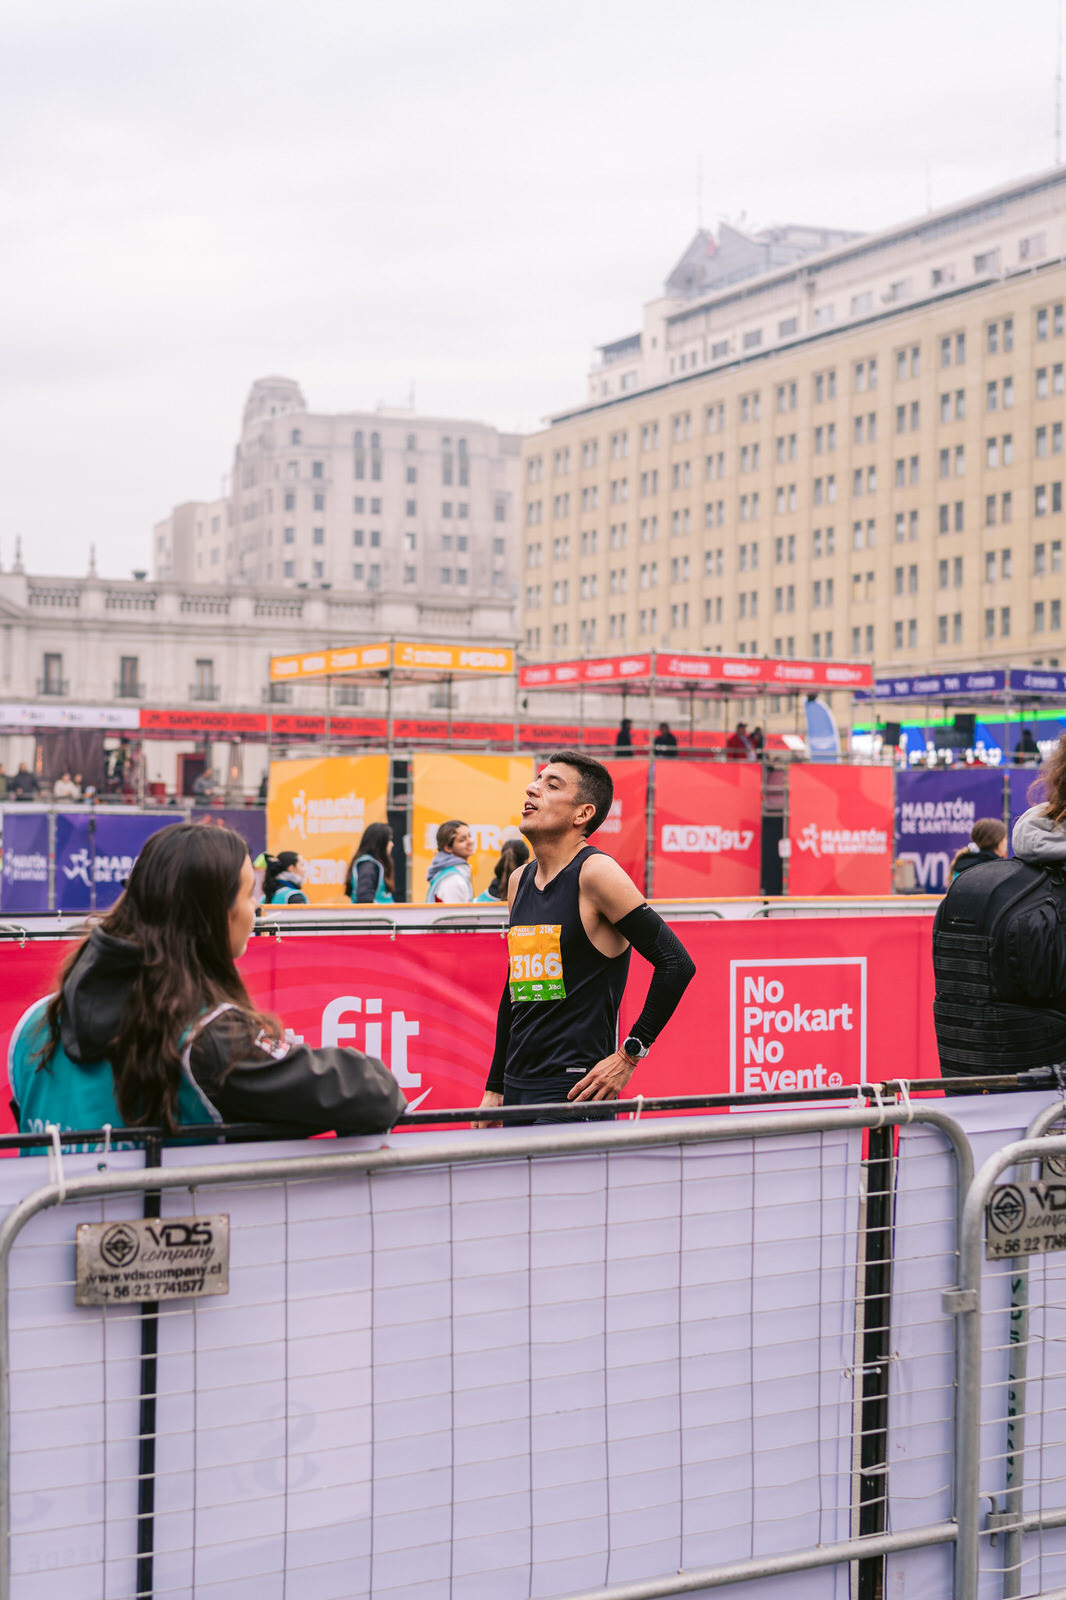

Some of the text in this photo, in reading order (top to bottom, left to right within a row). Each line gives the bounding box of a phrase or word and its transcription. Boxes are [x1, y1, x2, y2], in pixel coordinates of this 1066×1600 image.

[902, 797, 975, 819] MARATÓN
[821, 828, 888, 843] MARATÓN
[901, 820, 916, 834] DE
[821, 842, 888, 855] DE SANTIAGO
[744, 976, 784, 1004] No
[744, 1003, 853, 1034] Prokart
[321, 996, 422, 1088] fit
[744, 1036, 784, 1064] No
[744, 1064, 828, 1093] Event
[145, 1222, 213, 1247] VDS
[1024, 1236, 1040, 1251] 22
[140, 1246, 215, 1265] company
[86, 1263, 222, 1286] www.vdscompany.cl
[135, 1284, 151, 1296] 22
[155, 1279, 205, 1294] 7741577
